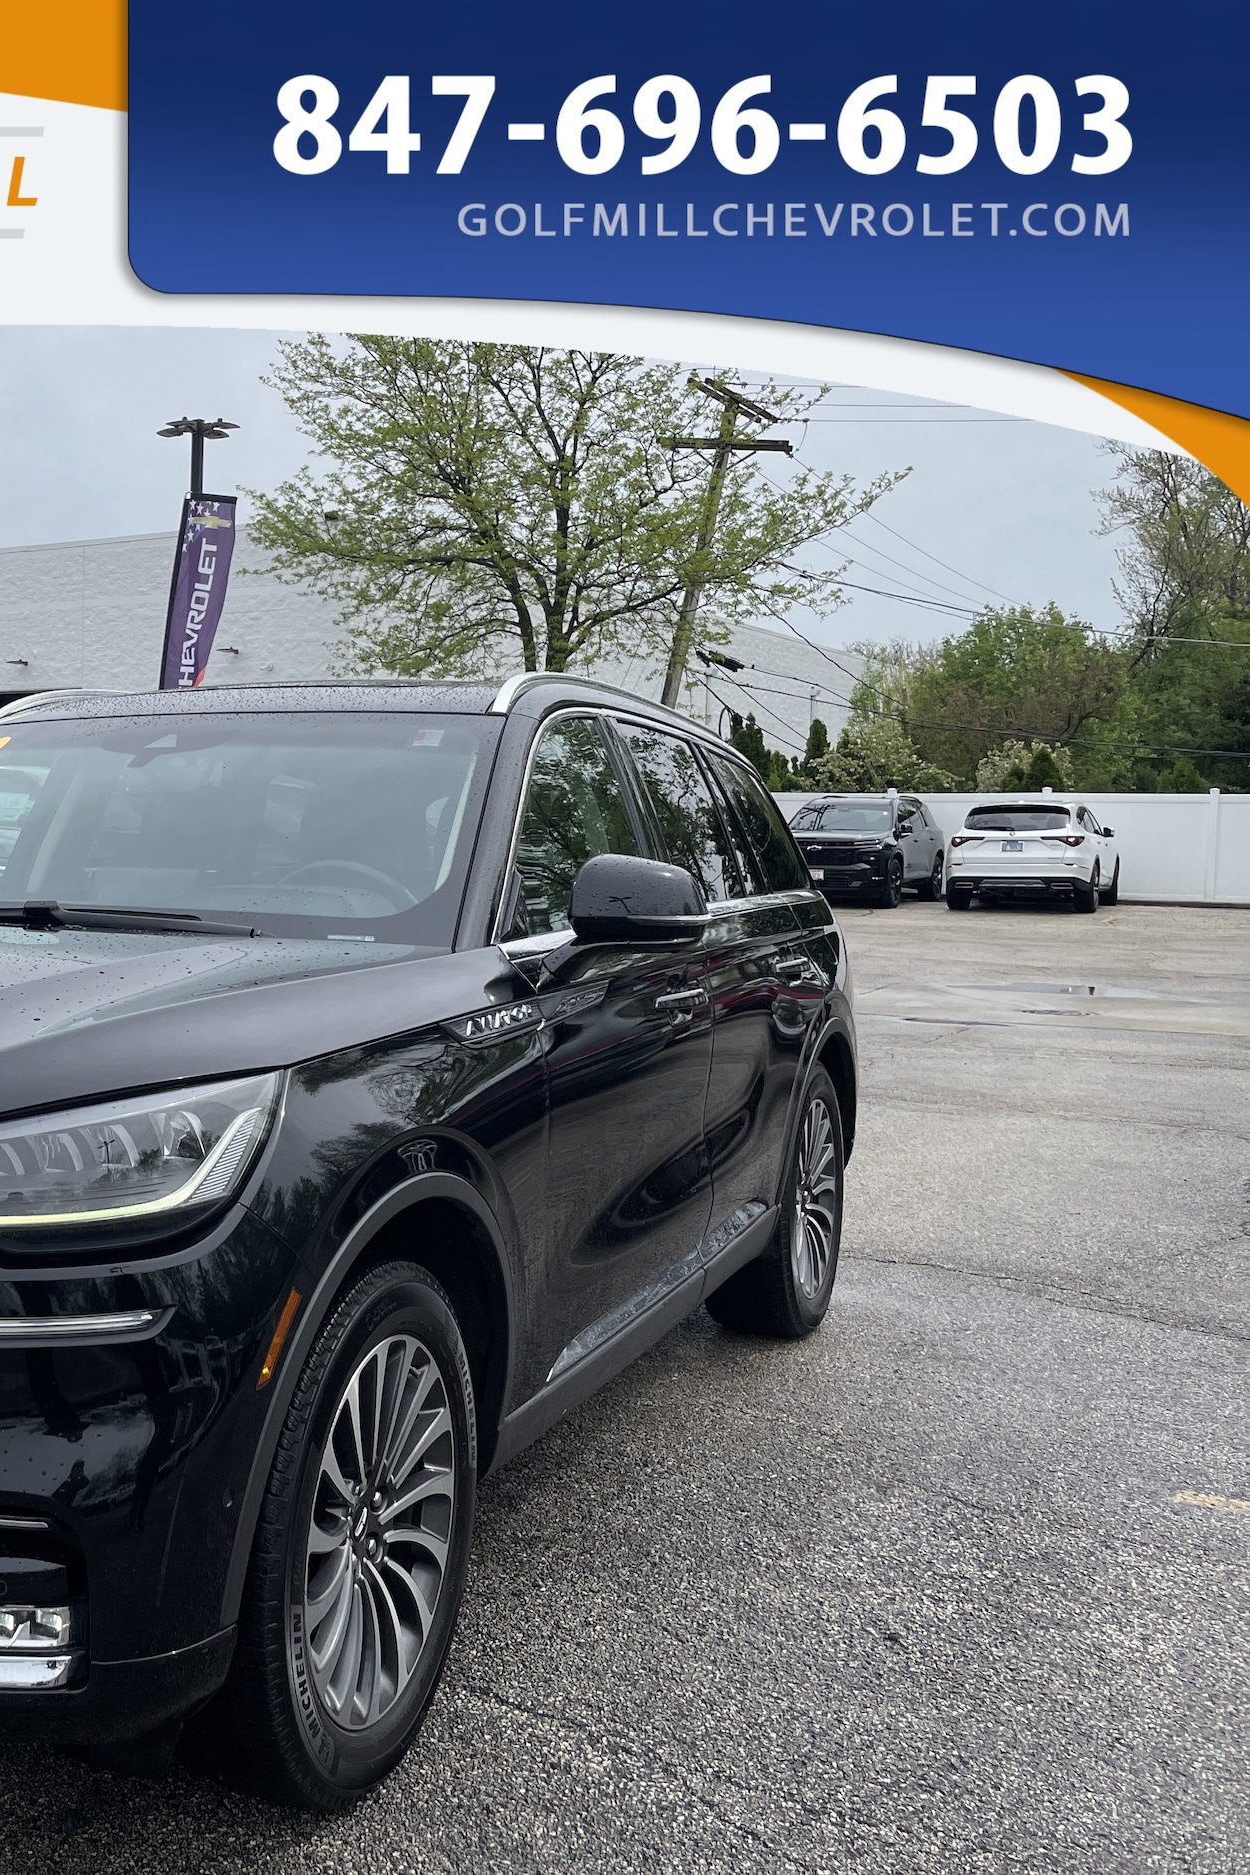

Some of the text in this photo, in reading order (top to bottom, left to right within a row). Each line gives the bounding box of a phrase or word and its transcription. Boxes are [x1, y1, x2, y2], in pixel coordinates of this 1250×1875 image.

[178, 537, 218, 689] HEVROLET
[458, 1353, 476, 1462] MICHELIN
[292, 1612, 321, 1740] MICHELIN
